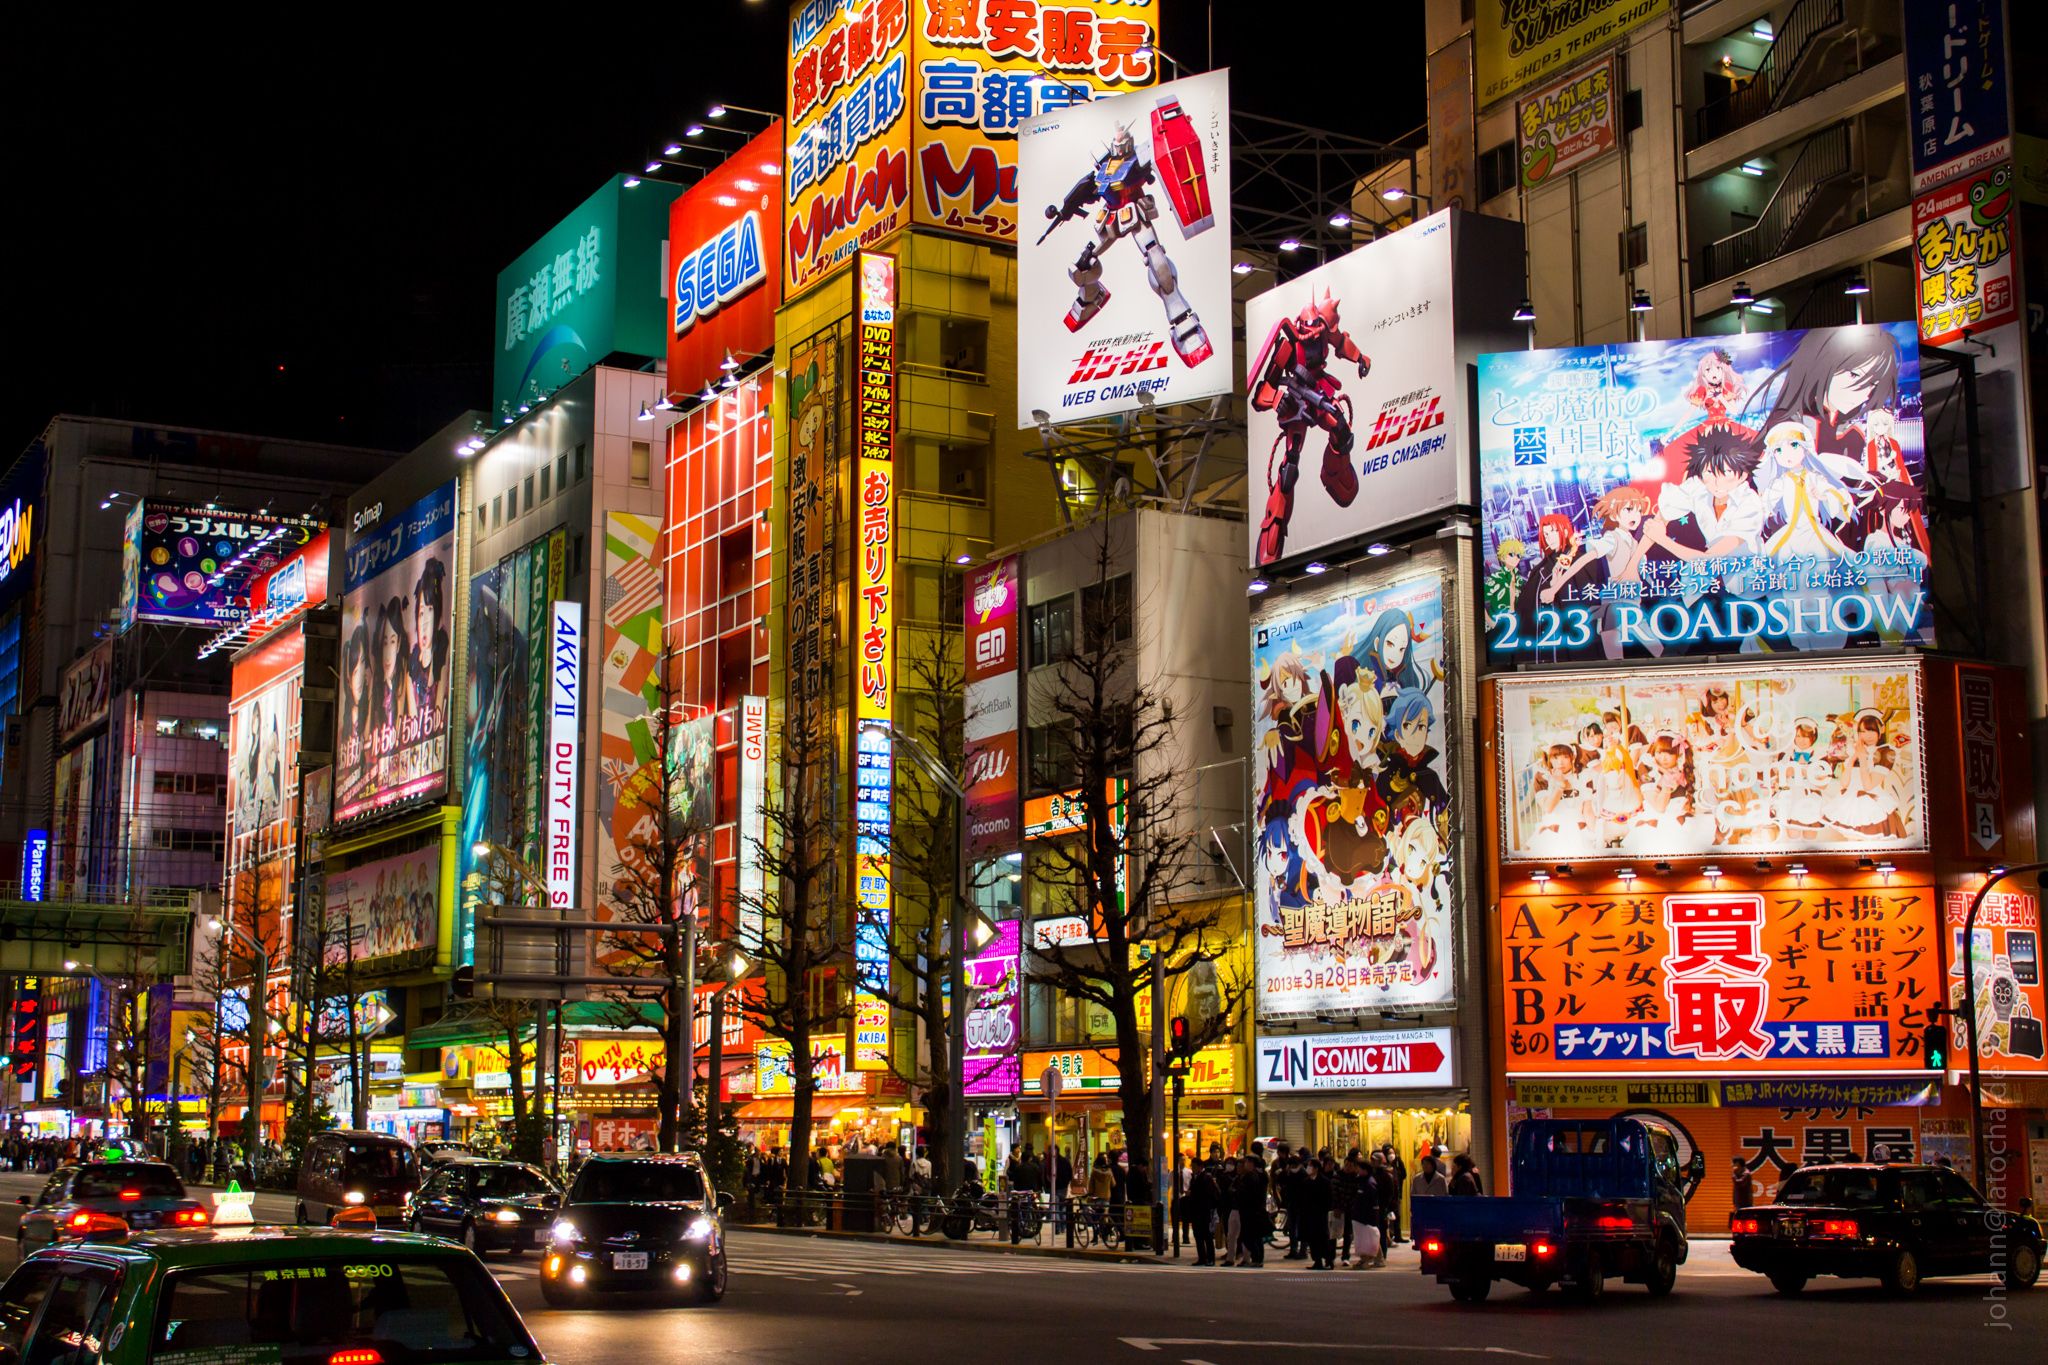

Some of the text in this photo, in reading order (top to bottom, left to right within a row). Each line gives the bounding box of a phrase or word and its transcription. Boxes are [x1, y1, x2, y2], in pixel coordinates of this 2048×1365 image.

[923, 0, 1151, 82] 激安販売
[1566, 39, 1581, 55] 7F
[788, 52, 905, 204] 高額買取
[1554, 97, 1609, 141] ゲラゲラ
[1918, 72, 1938, 158] 秋葉原店
[1919, 145, 2006, 188] AMENITY DREAM
[788, 146, 909, 286] Mulan
[832, 237, 859, 264] AKIBA
[1917, 217, 2010, 271] まんが
[675, 211, 767, 333] SEGA
[1921, 264, 1978, 309] 喫茶
[863, 308, 892, 321] あなたの
[1986, 291, 2009, 310] 3F
[864, 325, 890, 342] DVD
[1922, 299, 1983, 337] ゲラゲラ
[1089, 337, 1113, 349] FEVER
[863, 356, 891, 372] ゲーム
[867, 371, 886, 386] CD
[863, 386, 890, 401] アイドル
[863, 400, 891, 416] アニメ
[1062, 389, 1096, 408] WEB
[863, 415, 889, 430] コミック
[1514, 420, 1638, 467] 禁書目録
[1363, 453, 1389, 476] WEB
[184, 506, 248, 521] AMUSEMENT
[250, 513, 279, 523] PARK
[353, 501, 383, 533] Sofmap
[1494, 592, 1927, 650] 2.23 ROADSHOW
[555, 615, 578, 699] AKKY
[746, 704, 763, 761] GAME
[1960, 674, 2000, 800] 買取
[554, 742, 573, 809] DUTY
[860, 774, 889, 787] DVD
[972, 748, 1010, 785] au
[857, 788, 871, 801] 4F
[857, 822, 871, 835] 3F
[859, 808, 889, 820] DVD
[971, 815, 1011, 837] docomo
[1980, 807, 1993, 840] 入口
[553, 818, 570, 881] FREE
[859, 876, 887, 891] 買取
[860, 893, 887, 906] フロア
[1279, 891, 1399, 949] 聖魔導物語
[1586, 901, 1621, 987] アニメ
[1811, 896, 1847, 983] ホビー
[1550, 901, 1587, 1017] アイドル
[1619, 898, 1660, 1020] 美少女系
[1774, 898, 1812, 1020] フィギュア
[1849, 894, 1889, 1018] 携帯電話
[1266, 962, 1413, 993] 2013年3月28日発売予定
[1664, 895, 1773, 1058] 買取
[1888, 894, 1927, 1057] アップルとか
[857, 1014, 886, 1027] ムーラン
[857, 1032, 886, 1044] AKIBA
[1558, 1026, 1663, 1057] チケット
[1778, 1024, 1885, 1056] 大黒屋
[477, 1049, 494, 1073] Duty
[583, 1041, 623, 1082] DUTY
[1262, 1040, 1308, 1088] ZIN
[1313, 1045, 1411, 1075] COMIC ZIN
[1313, 1076, 1368, 1088] Akihabara
[1521, 1085, 1618, 1095] MONEY TRANSFER
[1628, 1085, 1697, 1095] WESTERN
[1649, 1094, 1697, 1104] UNION
[263, 1266, 328, 1281] 東京無線
